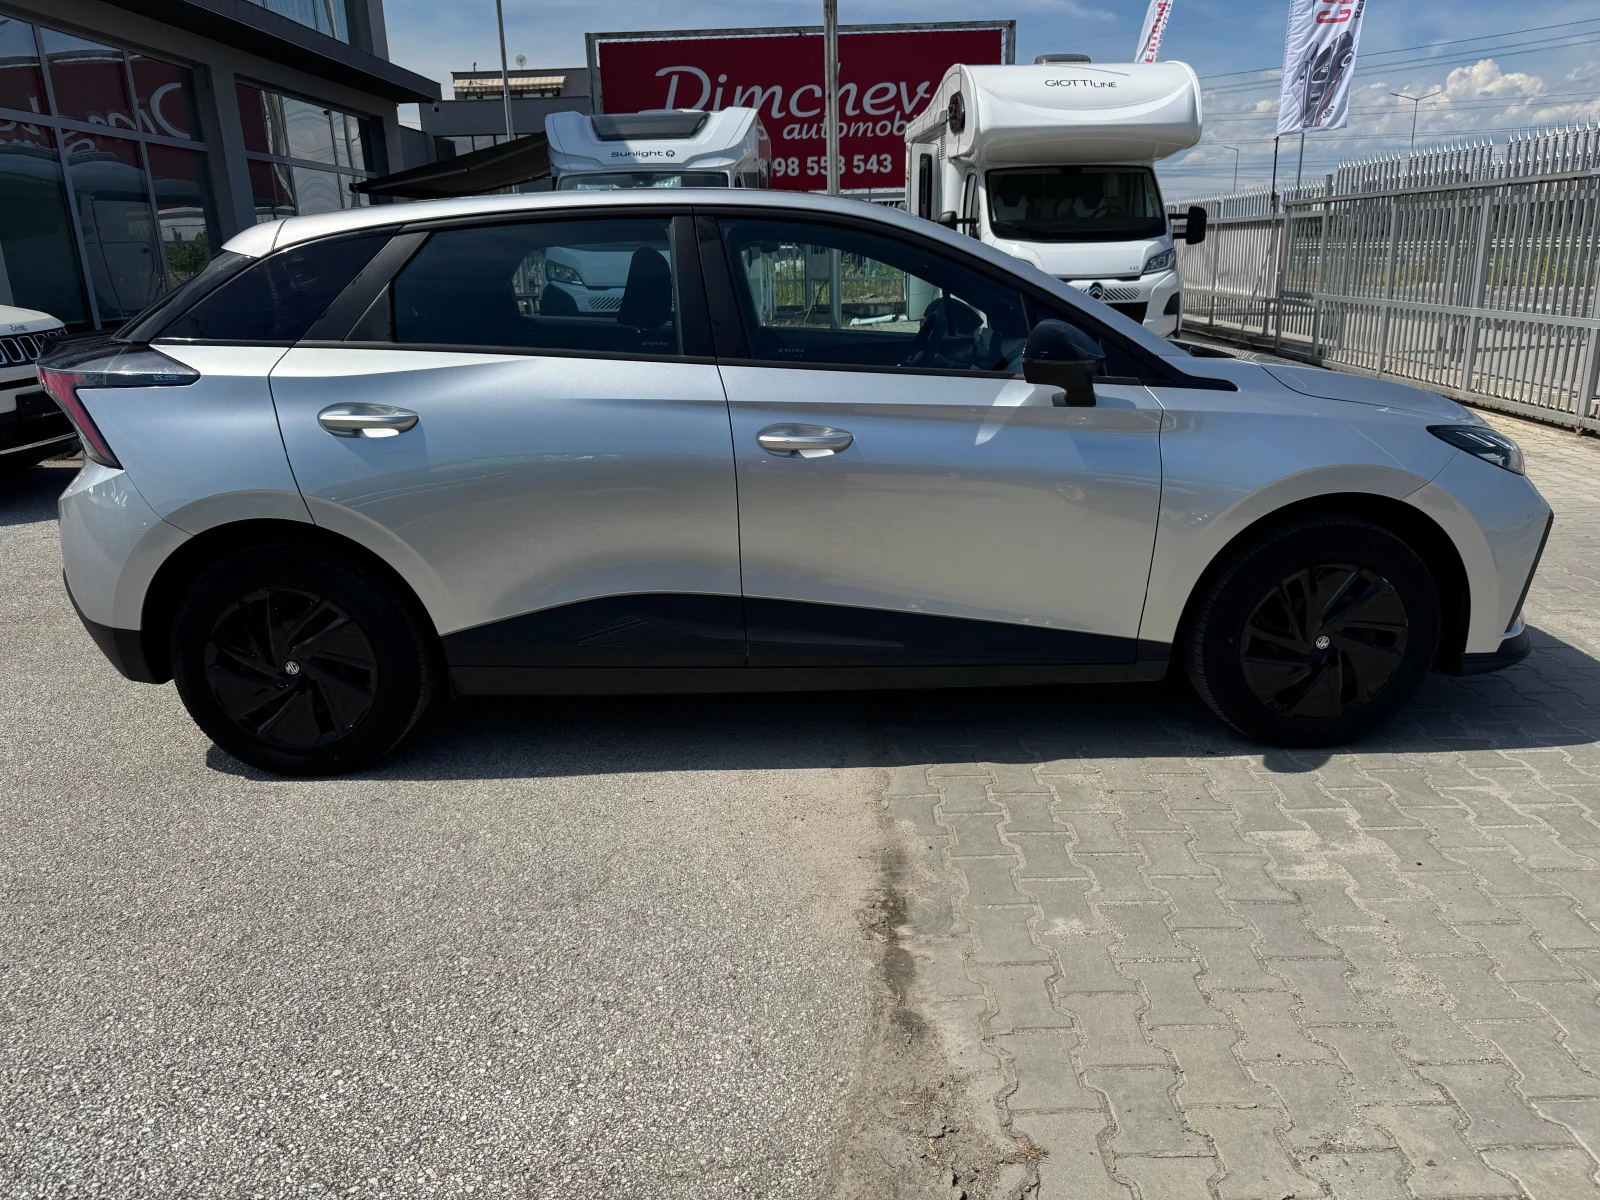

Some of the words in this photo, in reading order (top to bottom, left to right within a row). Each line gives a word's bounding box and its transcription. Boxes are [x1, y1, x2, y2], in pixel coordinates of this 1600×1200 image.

[1316, 0, 1354, 24] C
[655, 62, 931, 119] Dimchev
[783, 111, 918, 140] automob
[772, 157, 800, 177] 98
[853, 153, 892, 175] 543
